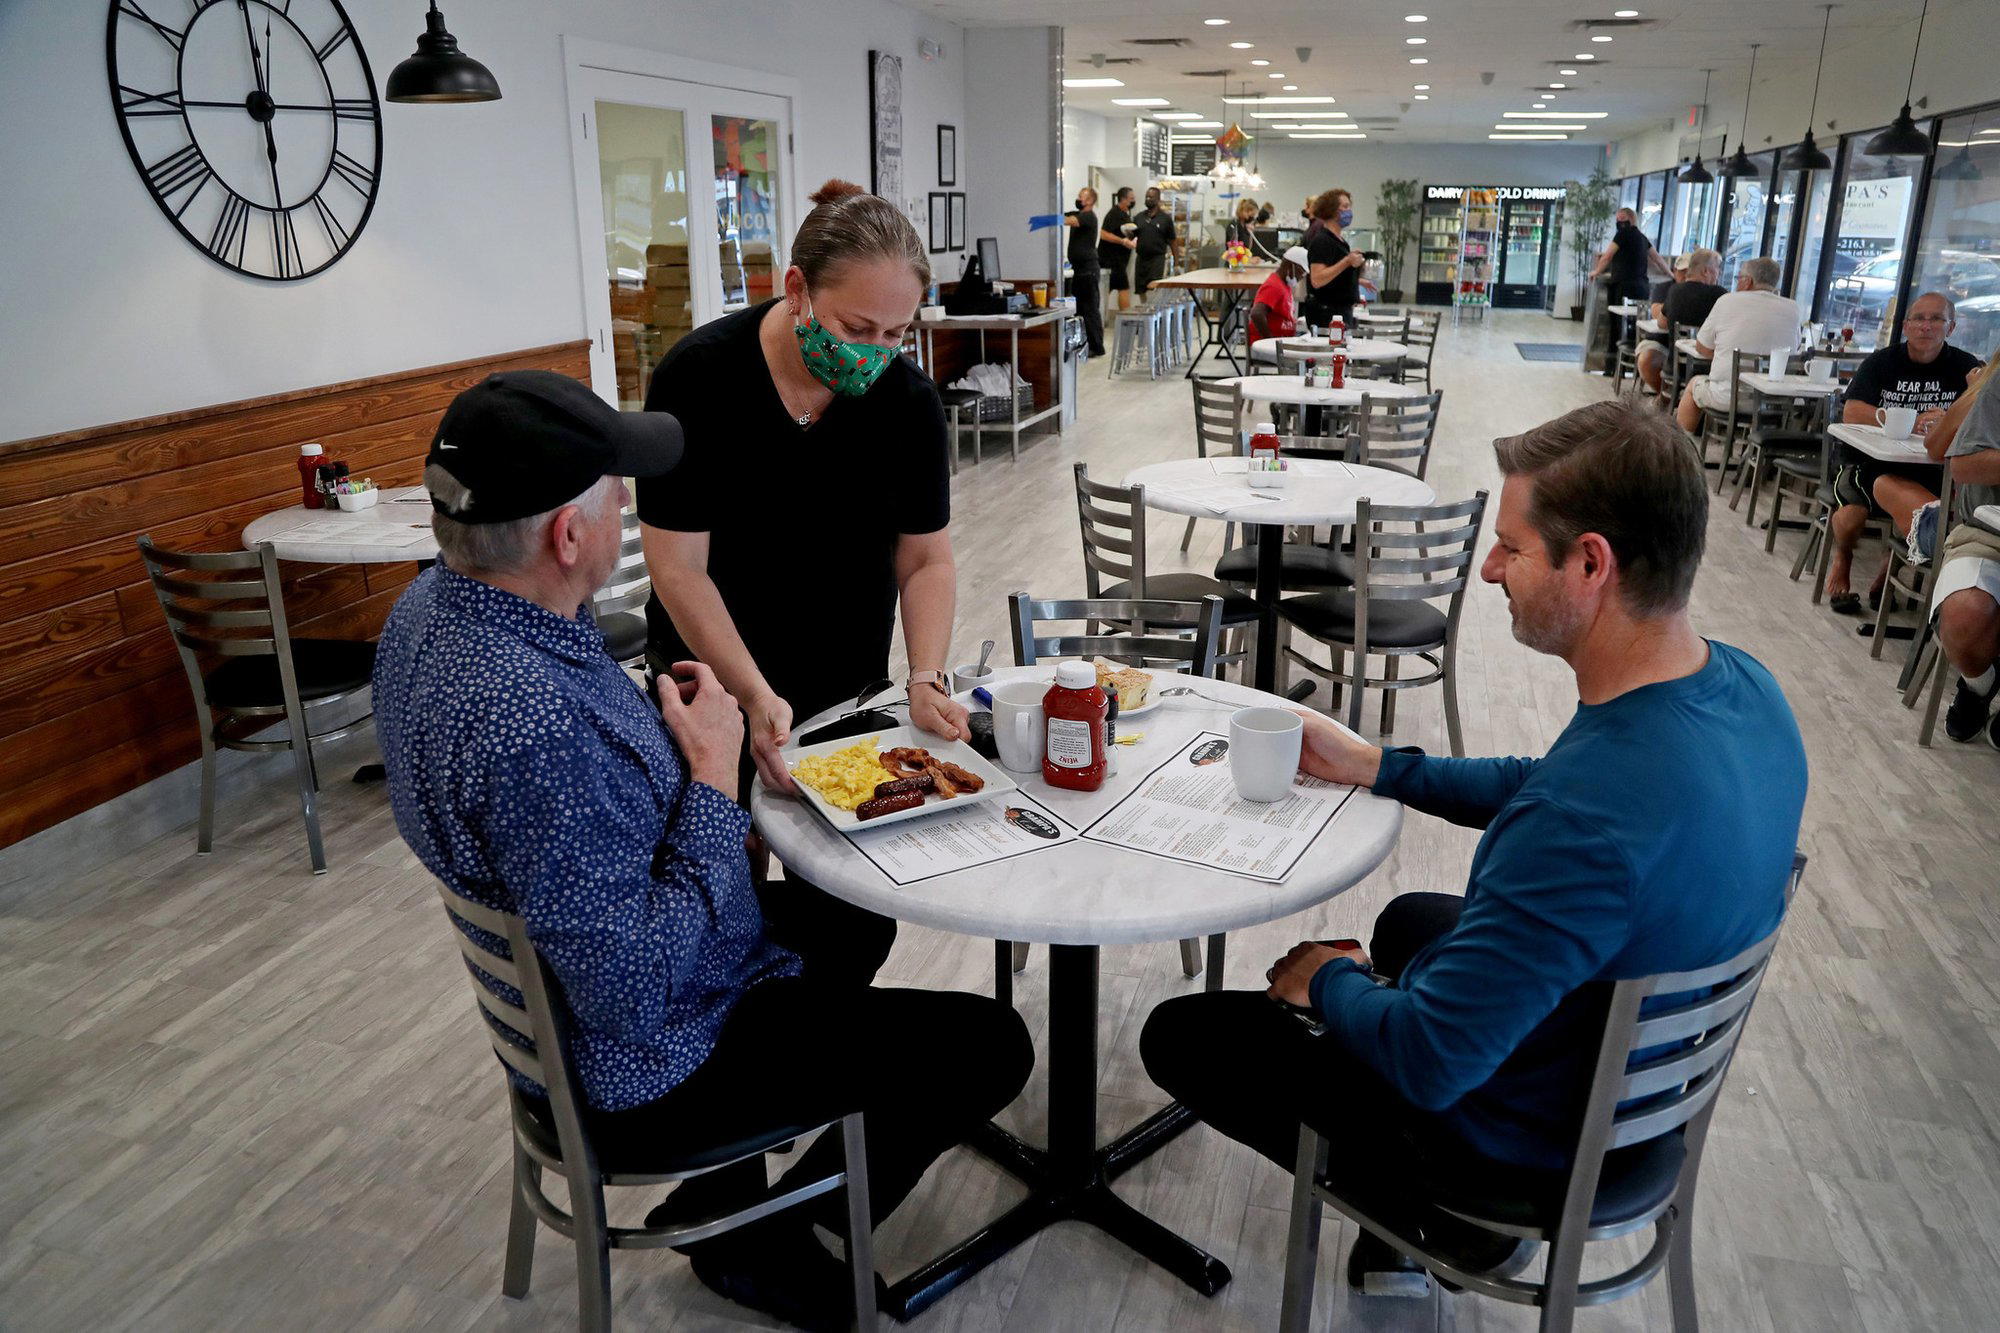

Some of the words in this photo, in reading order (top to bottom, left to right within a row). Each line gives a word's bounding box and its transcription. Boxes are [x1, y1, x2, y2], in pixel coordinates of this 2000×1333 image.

[1428, 187, 1463, 199] DAIRY
[1896, 380, 1920, 393] DEAR
[1941, 391, 1957, 400] DAY
[1058, 755, 1079, 764] HEINZ
